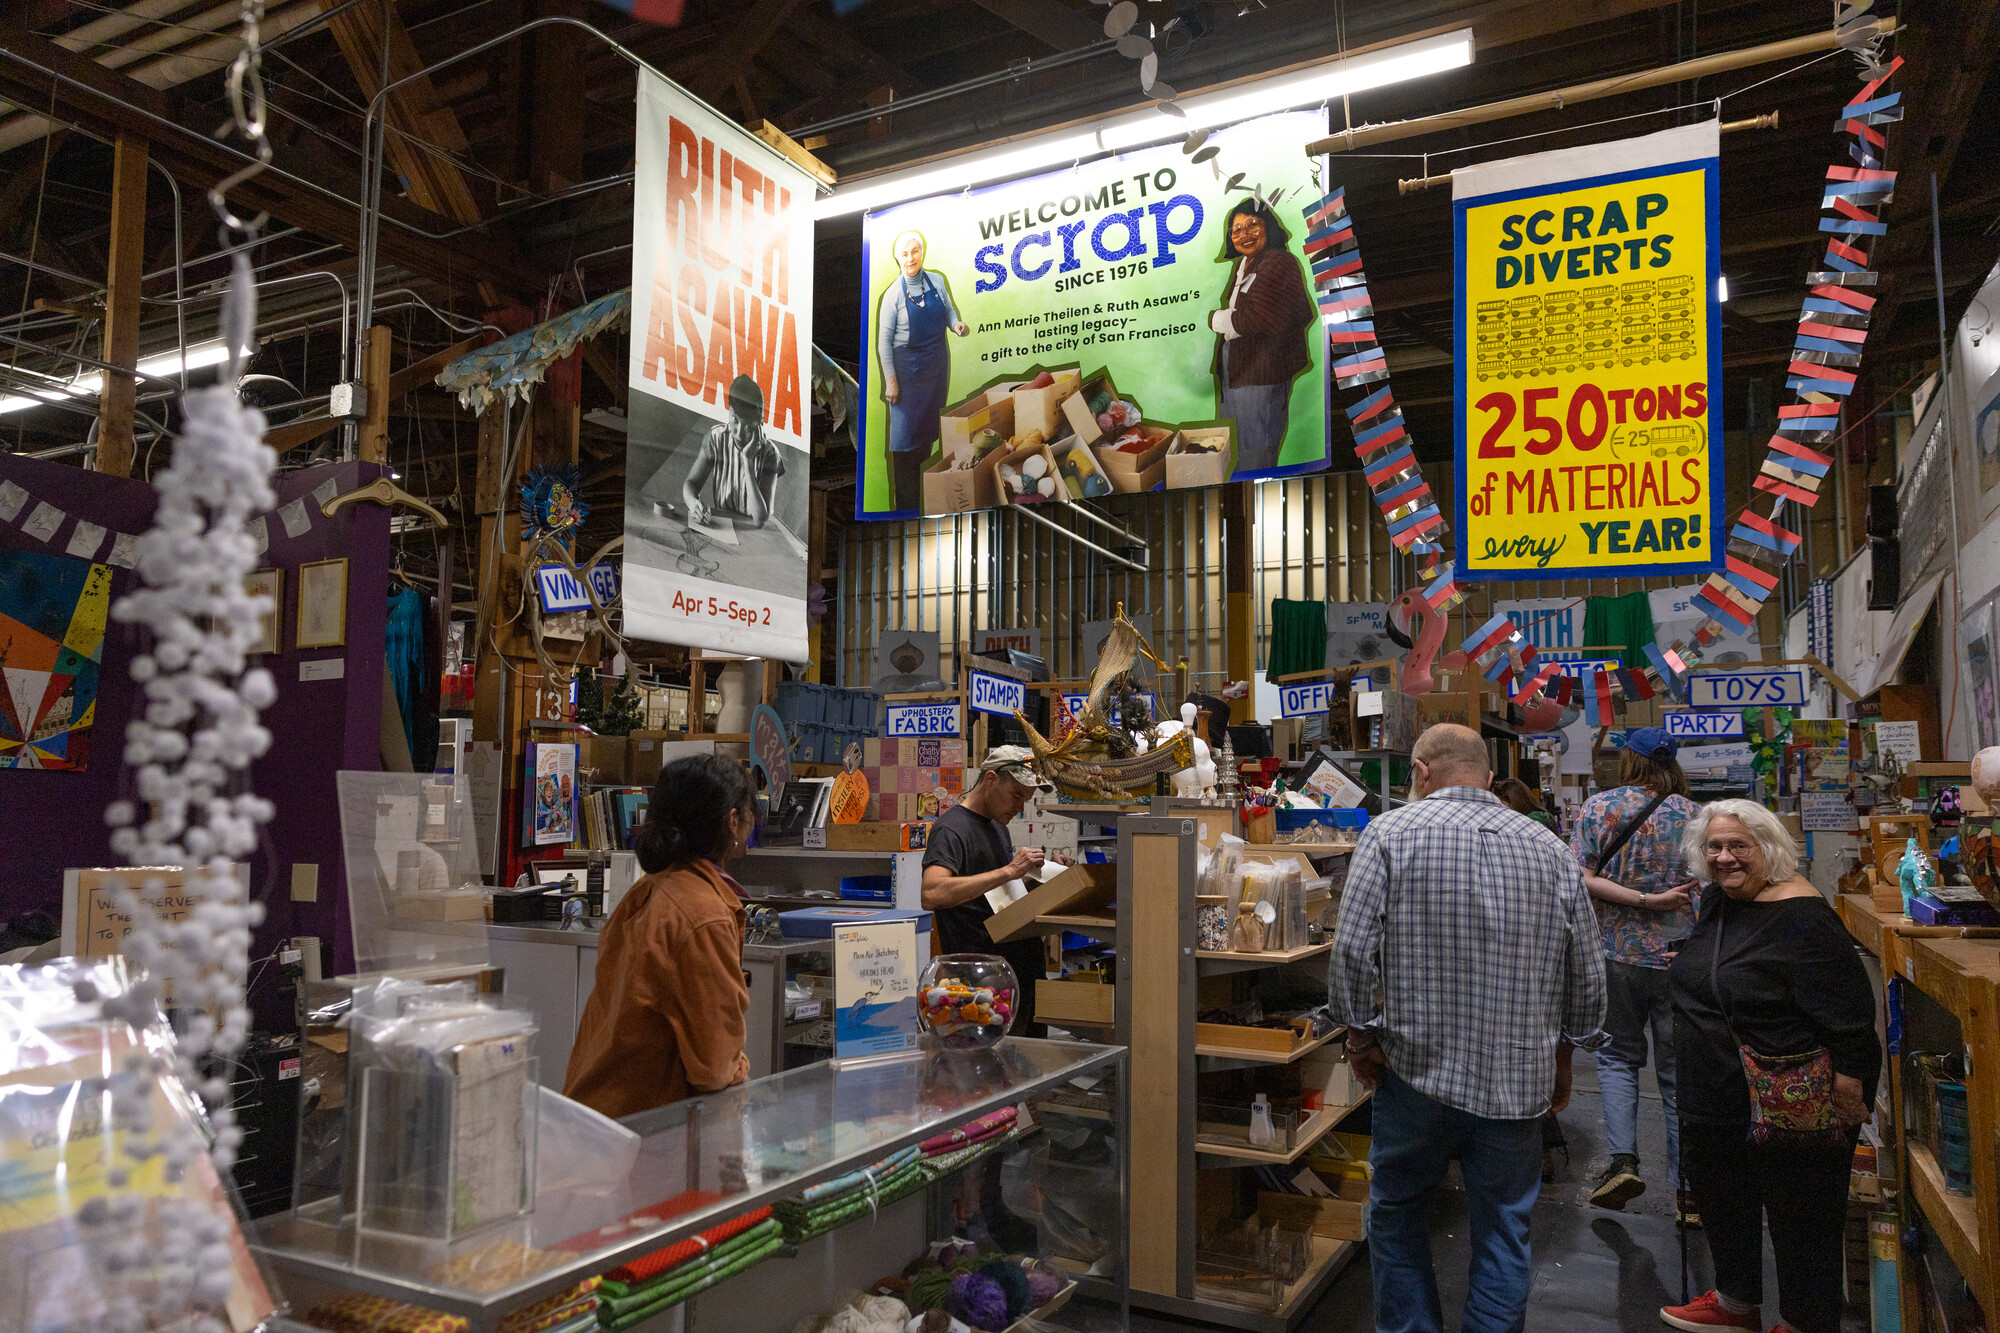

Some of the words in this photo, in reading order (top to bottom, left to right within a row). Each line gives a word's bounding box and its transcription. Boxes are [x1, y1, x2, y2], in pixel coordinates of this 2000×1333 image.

[666, 115, 790, 306] RUTH
[978, 180, 1126, 240] WELCOME
[1134, 168, 1176, 198] TO
[1499, 193, 1668, 250] SCRAP
[974, 194, 1204, 294] scrap
[1054, 270, 1104, 293] SINCE
[1109, 261, 1148, 281] 1976
[1496, 234, 1674, 289] DIVERTS
[978, 318, 1002, 334] Ann
[1004, 314, 1040, 329] Marie
[1044, 306, 1090, 322] Theilen
[1094, 304, 1103, 314] &
[1107, 300, 1140, 312] Ruth
[1143, 290, 1200, 308] Asawa's
[642, 250, 802, 437] ASAWA
[980, 352, 988, 362] a
[991, 348, 1012, 363] gift
[1016, 346, 1028, 357] to
[1032, 342, 1053, 356] the
[1056, 338, 1079, 353] city
[1082, 334, 1096, 346] of
[1099, 330, 1125, 344] San
[1129, 322, 1196, 340] Francisco
[1034, 323, 1078, 341] lasting
[1474, 383, 1608, 460] 250
[1608, 381, 1708, 424] TONS
[1628, 430, 1650, 448] 25
[1470, 471, 1498, 517] of
[1506, 458, 1701, 514] MATERIALS
[1476, 534, 1566, 568] every
[1580, 514, 1702, 554] YEAR!
[545, 570, 615, 602] VINGE
[672, 590, 702, 615] Apr
[763, 608, 770, 626] 2
[1347, 616, 1360, 624] SF
[1361, 612, 1379, 620] MO
[1673, 602, 1688, 612] SF
[1507, 608, 1573, 648] RUTH
[536, 688, 562, 720] 13
[976, 678, 1019, 709] STAMPS
[1705, 676, 1786, 702] TOYS
[896, 716, 954, 732] FABRIC
[902, 707, 954, 718] UPHOLSTERY
[1670, 716, 1736, 734] PARTY
[919, 745, 940, 756] Chatty
[919, 756, 940, 766] Cathy
[140, 896, 196, 908] SERVE
[105, 914, 132, 922] THE
[96, 928, 114, 940] TO
[876, 948, 899, 959] Sketching
[881, 966, 894, 975] HEAD
